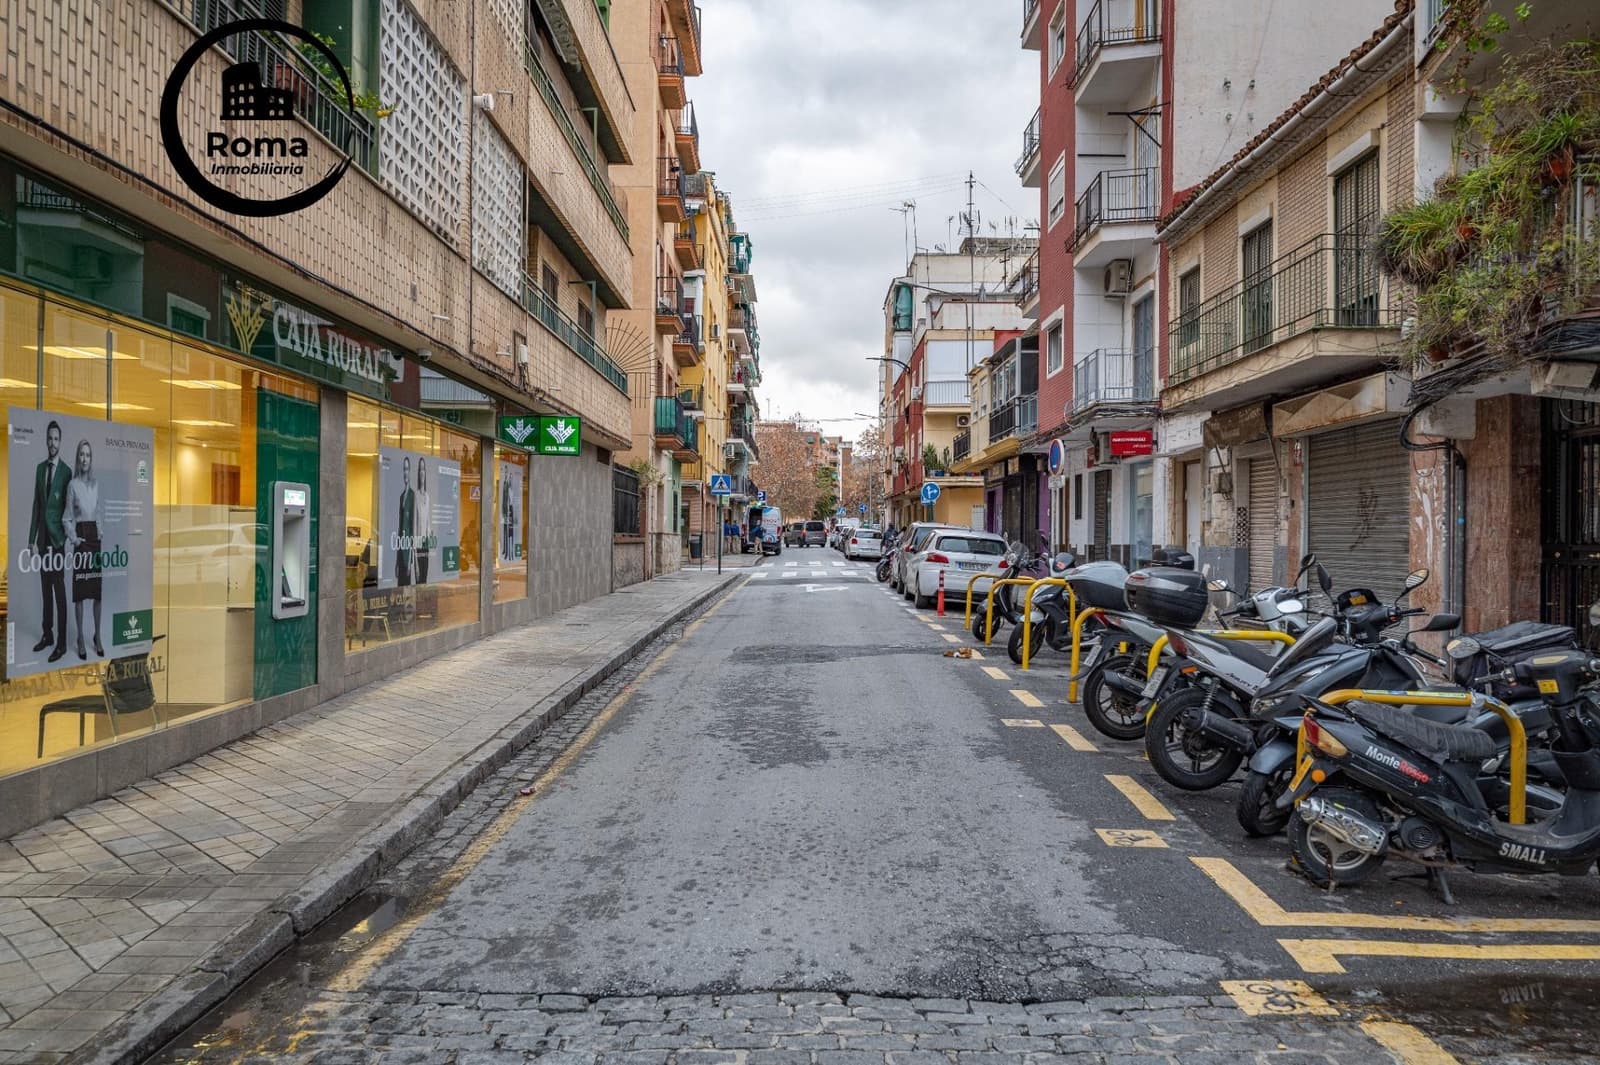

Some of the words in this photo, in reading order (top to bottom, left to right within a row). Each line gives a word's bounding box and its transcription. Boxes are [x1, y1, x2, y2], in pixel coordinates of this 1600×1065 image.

[273, 307, 323, 361] CAJA
[326, 330, 384, 384] RURAL
[105, 437, 126, 448] BANCA
[126, 440, 150, 450] PRIVADA
[18, 544, 129, 573] Codoconcodo
[123, 655, 166, 679] RURAL
[1365, 745, 1431, 785] MonteRosso
[1499, 842, 1547, 865] SMALL
